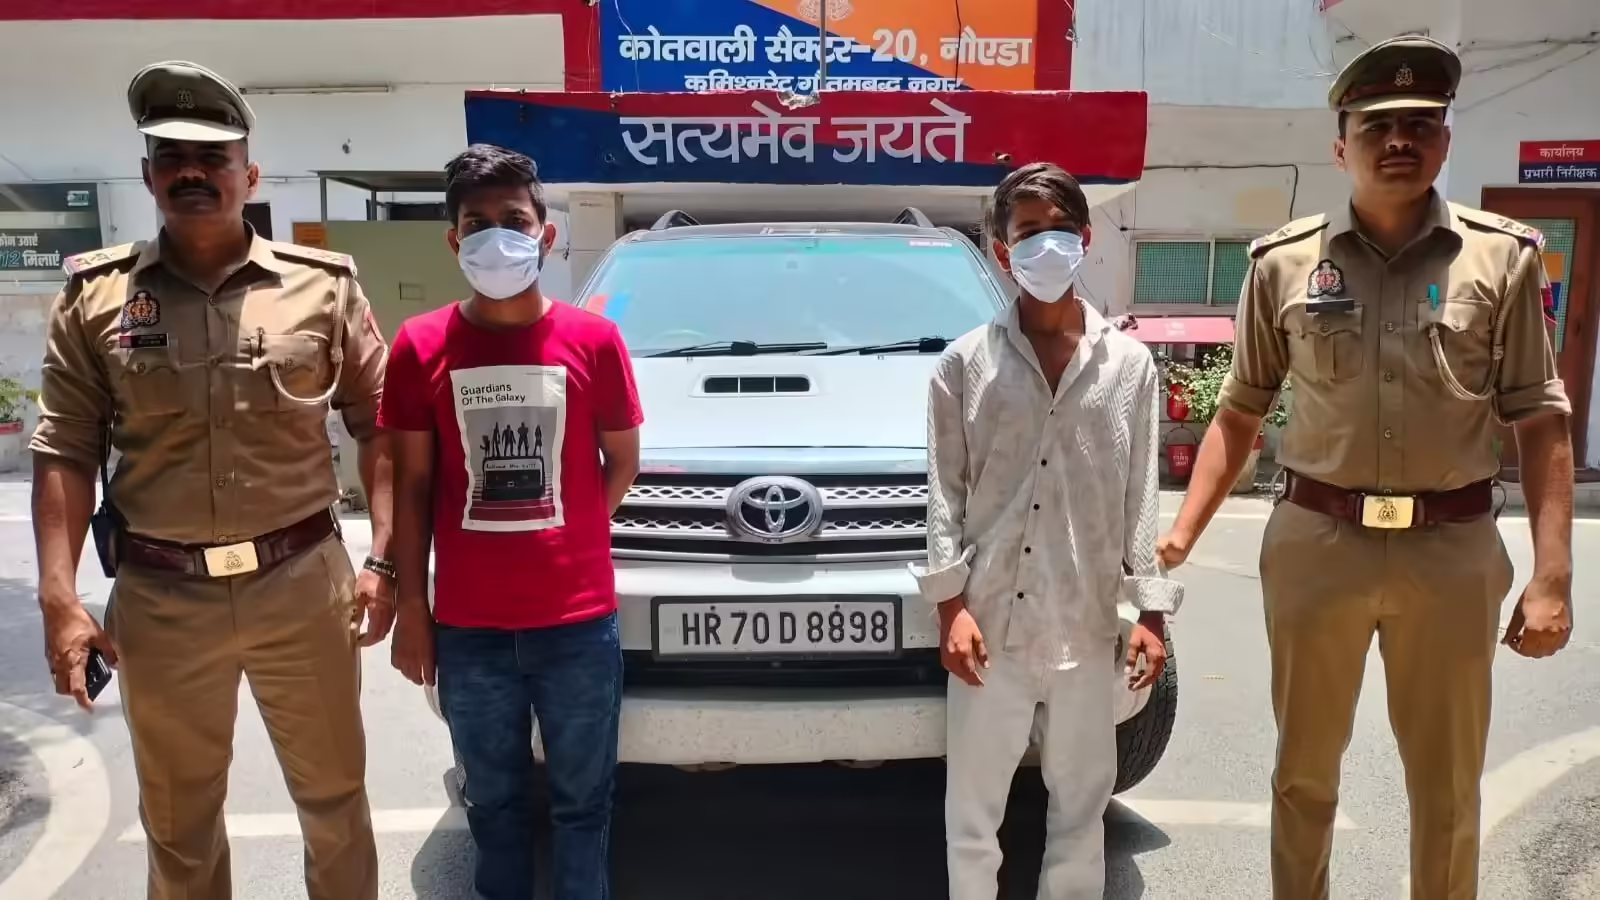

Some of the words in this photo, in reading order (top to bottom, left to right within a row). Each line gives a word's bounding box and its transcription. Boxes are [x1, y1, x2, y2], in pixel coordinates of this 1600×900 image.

[618, 24, 757, 63] कोतवाली
[939, 25, 1032, 67] नौएडा
[908, 77, 964, 91] नगर
[619, 100, 820, 165] सत्यमेव
[831, 97, 972, 164] जयते
[1538, 144, 1584, 160] कार्यालय
[1524, 165, 1552, 179] प्रभारी
[1556, 165, 1597, 178] निरीक्षक
[460, 384, 512, 396] Guardians
[462, 397, 472, 406] Of
[474, 395, 494, 405] The
[495, 393, 526, 404] Galaxy
[682, 612, 721, 646] HR
[807, 610, 888, 644] 8898
